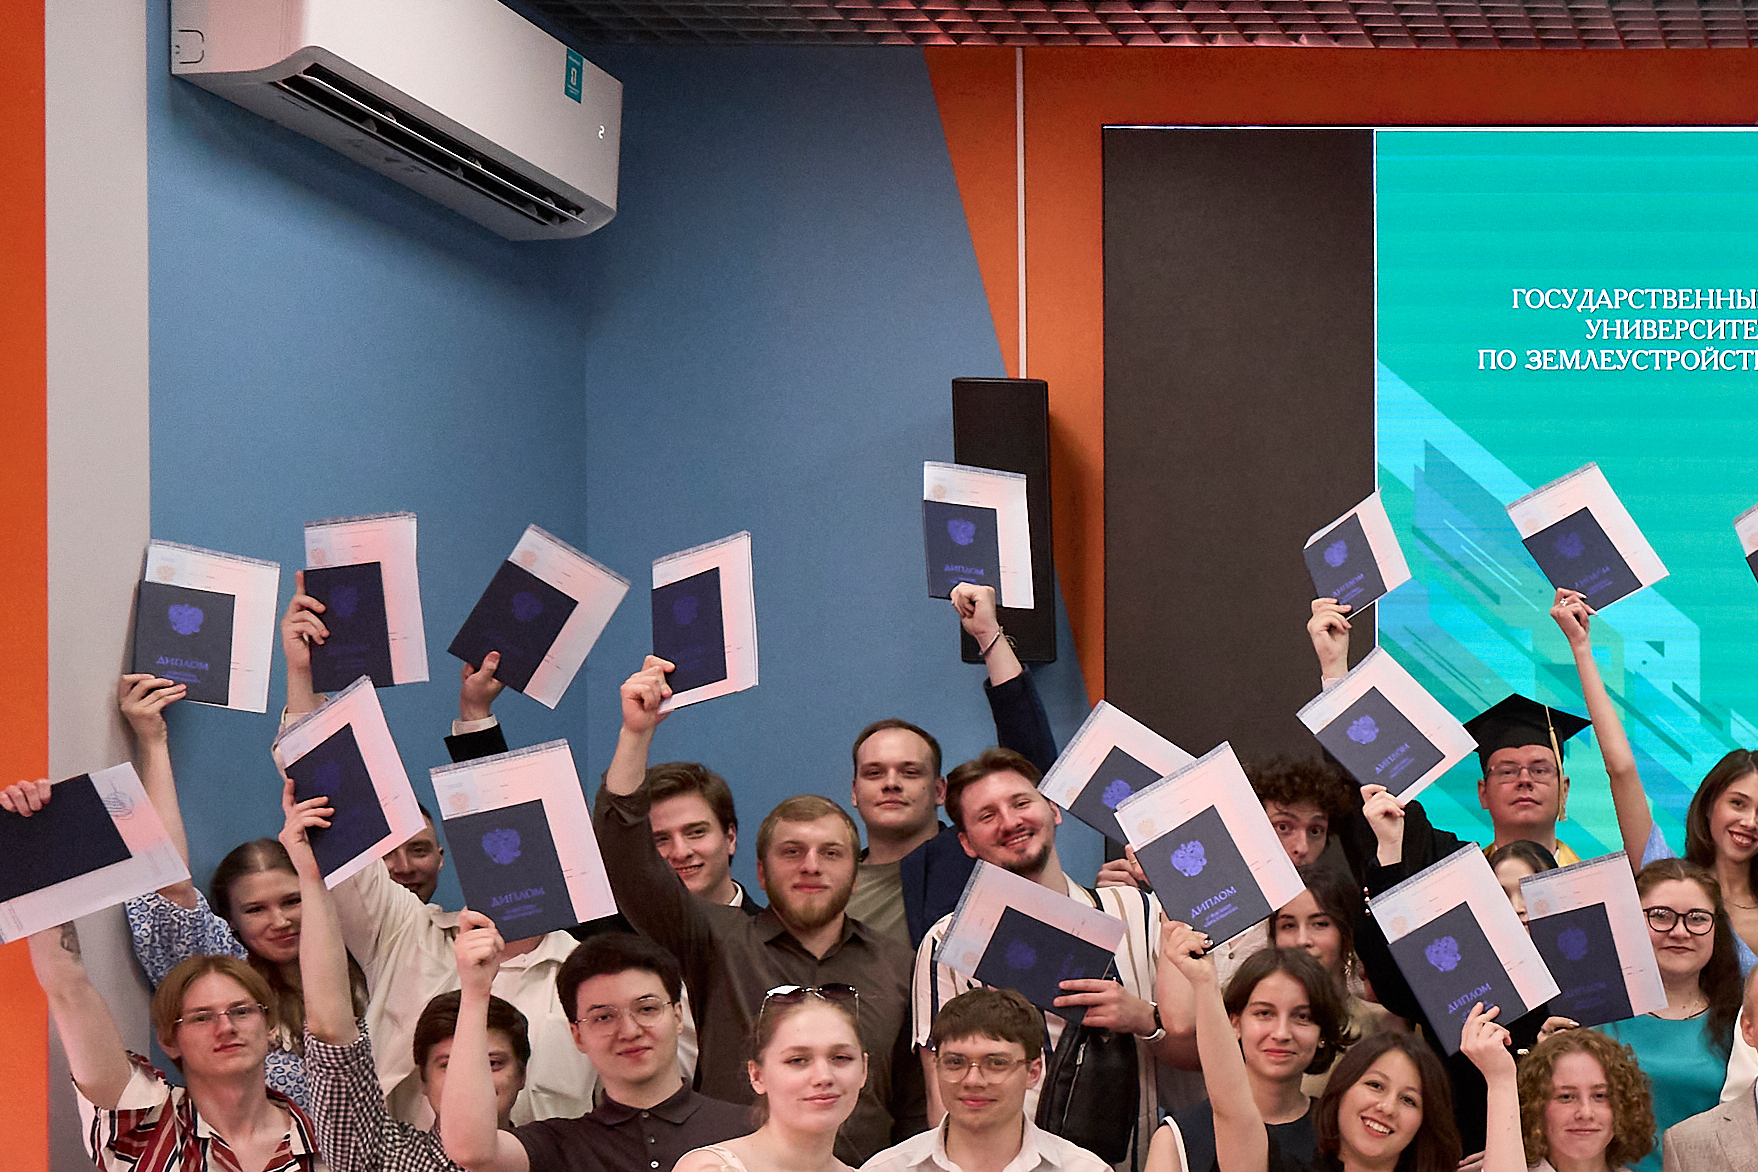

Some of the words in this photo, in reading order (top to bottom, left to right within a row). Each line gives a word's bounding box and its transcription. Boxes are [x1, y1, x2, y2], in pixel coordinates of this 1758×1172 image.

[1477, 349, 1517, 371] ПО
[155, 655, 210, 672] ДИПЛОМ
[491, 886, 546, 908] ДИПЛОМ
[1190, 885, 1238, 920] ДИПЛОМ
[1448, 982, 1493, 1015] ДИПЛОМ
